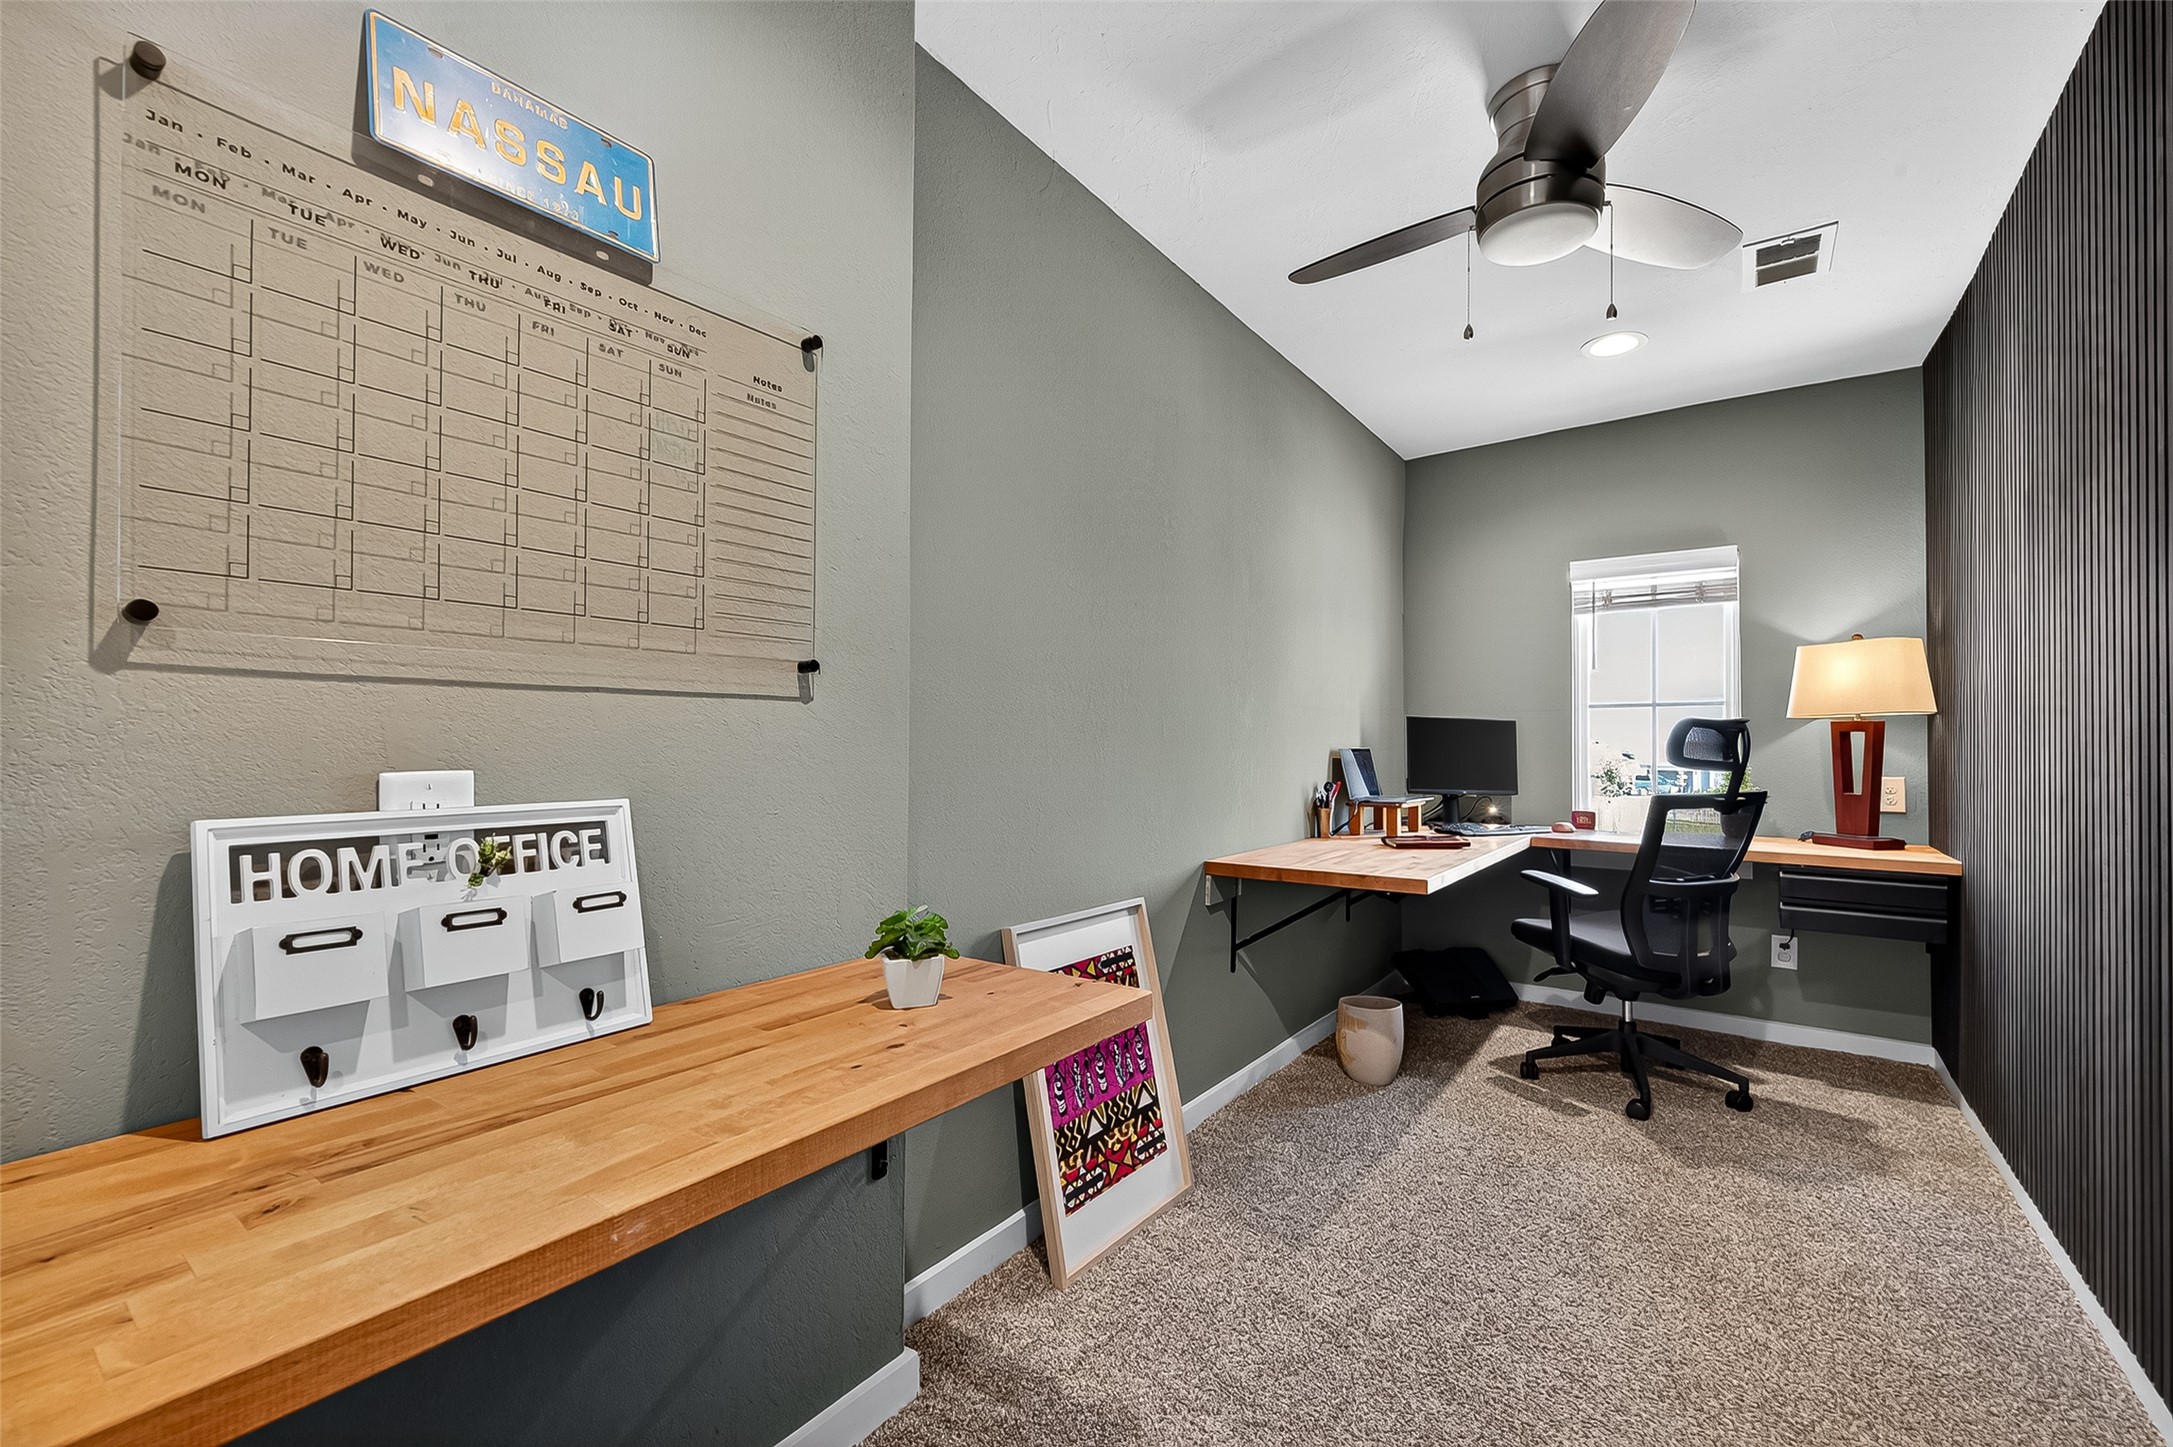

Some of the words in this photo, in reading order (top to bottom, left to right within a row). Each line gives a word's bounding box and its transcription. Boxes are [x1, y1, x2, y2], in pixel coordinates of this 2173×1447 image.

[122, 131, 161, 156] Jan
[391, 65, 643, 222] NASSAU
[145, 108, 184, 133] Jan
[216, 136, 253, 159] Feb
[281, 163, 316, 184] Mar
[342, 188, 374, 207] Apr
[396, 208, 428, 230] May
[449, 229, 476, 248] Jun
[496, 248, 517, 264] Jul
[536, 265, 562, 283] Aug
[579, 281, 602, 298] Sep
[618, 297, 639, 312] Oct
[654, 311, 675, 325] Nov
[688, 324, 707, 338] Dec
[152, 184, 206, 214] MON
[174, 161, 226, 190] MON
[287, 203, 327, 228] TUE
[380, 234, 421, 261] WED
[468, 268, 500, 290] THU
[543, 298, 567, 315] FRI
[607, 321, 633, 338] SAT
[666, 343, 691, 359] SUN
[434, 253, 462, 272] Jun
[568, 303, 592, 319] Sep
[267, 226, 308, 250] TUE
[362, 260, 405, 284] WED
[453, 292, 487, 313] THU
[531, 320, 555, 337] FRI
[598, 343, 624, 358] SAT
[658, 363, 682, 378] SUN
[746, 392, 778, 410] Notes
[752, 375, 784, 393] Notes
[237, 841, 425, 904] HOME
